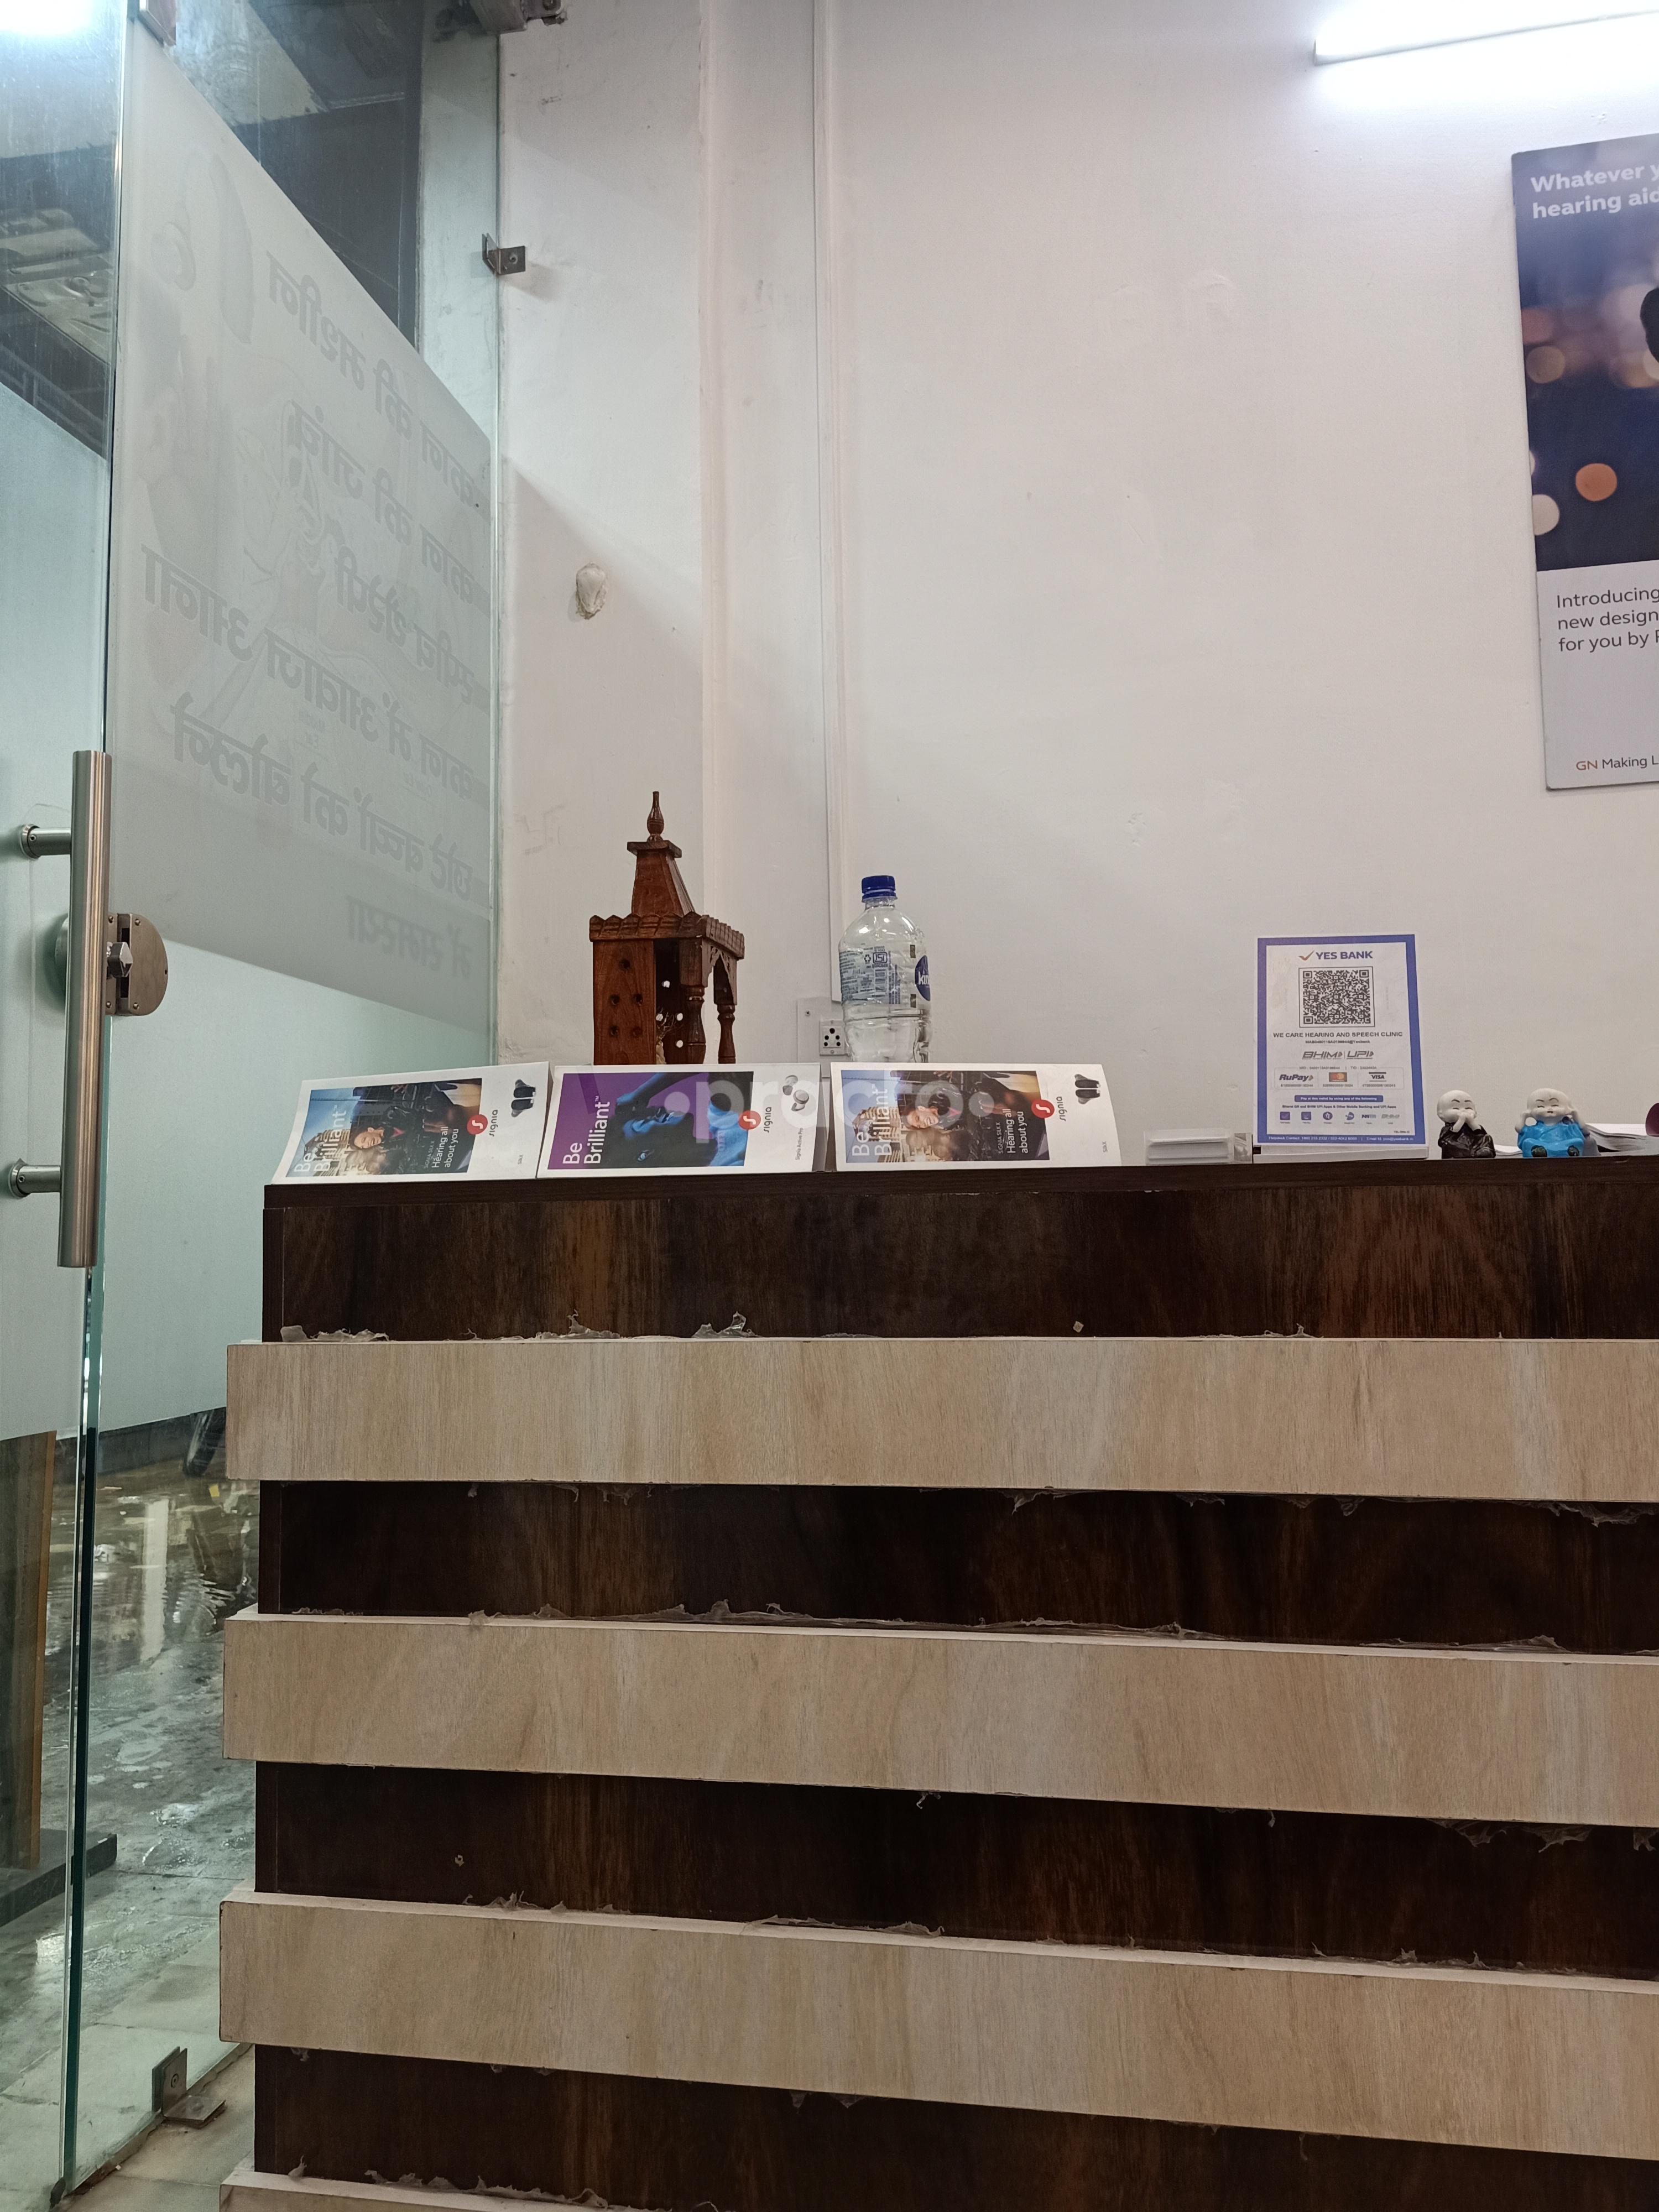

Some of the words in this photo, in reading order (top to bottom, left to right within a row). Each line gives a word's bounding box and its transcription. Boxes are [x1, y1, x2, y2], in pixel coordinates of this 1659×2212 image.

[1530, 165, 1645, 192] Whatever
[1532, 194, 1622, 219] hearing
[1558, 615, 1595, 630] new
[1558, 637, 1585, 652] for
[1589, 636, 1623, 653] you
[1627, 631, 1650, 649] by
[1576, 760, 1598, 771] GN
[1601, 757, 1648, 770] Making
[1315, 952, 1338, 960] YES
[1340, 951, 1373, 960] BANK
[764, 1107, 773, 1133] signia
[1003, 1109, 1011, 1118] all
[1016, 1112, 1027, 1126] you
[1056, 1097, 1067, 1121] signia
[489, 1109, 498, 1137] signia
[444, 1145, 456, 1167] about
[451, 1129, 459, 1144] you
[852, 1131, 869, 1156] Be
[1006, 1120, 1016, 1153] Hearing
[1018, 1127, 1028, 1154] about
[294, 1153, 313, 1172] Be
[431, 1137, 448, 1168] Hearing
[562, 1142, 583, 1164] Be
